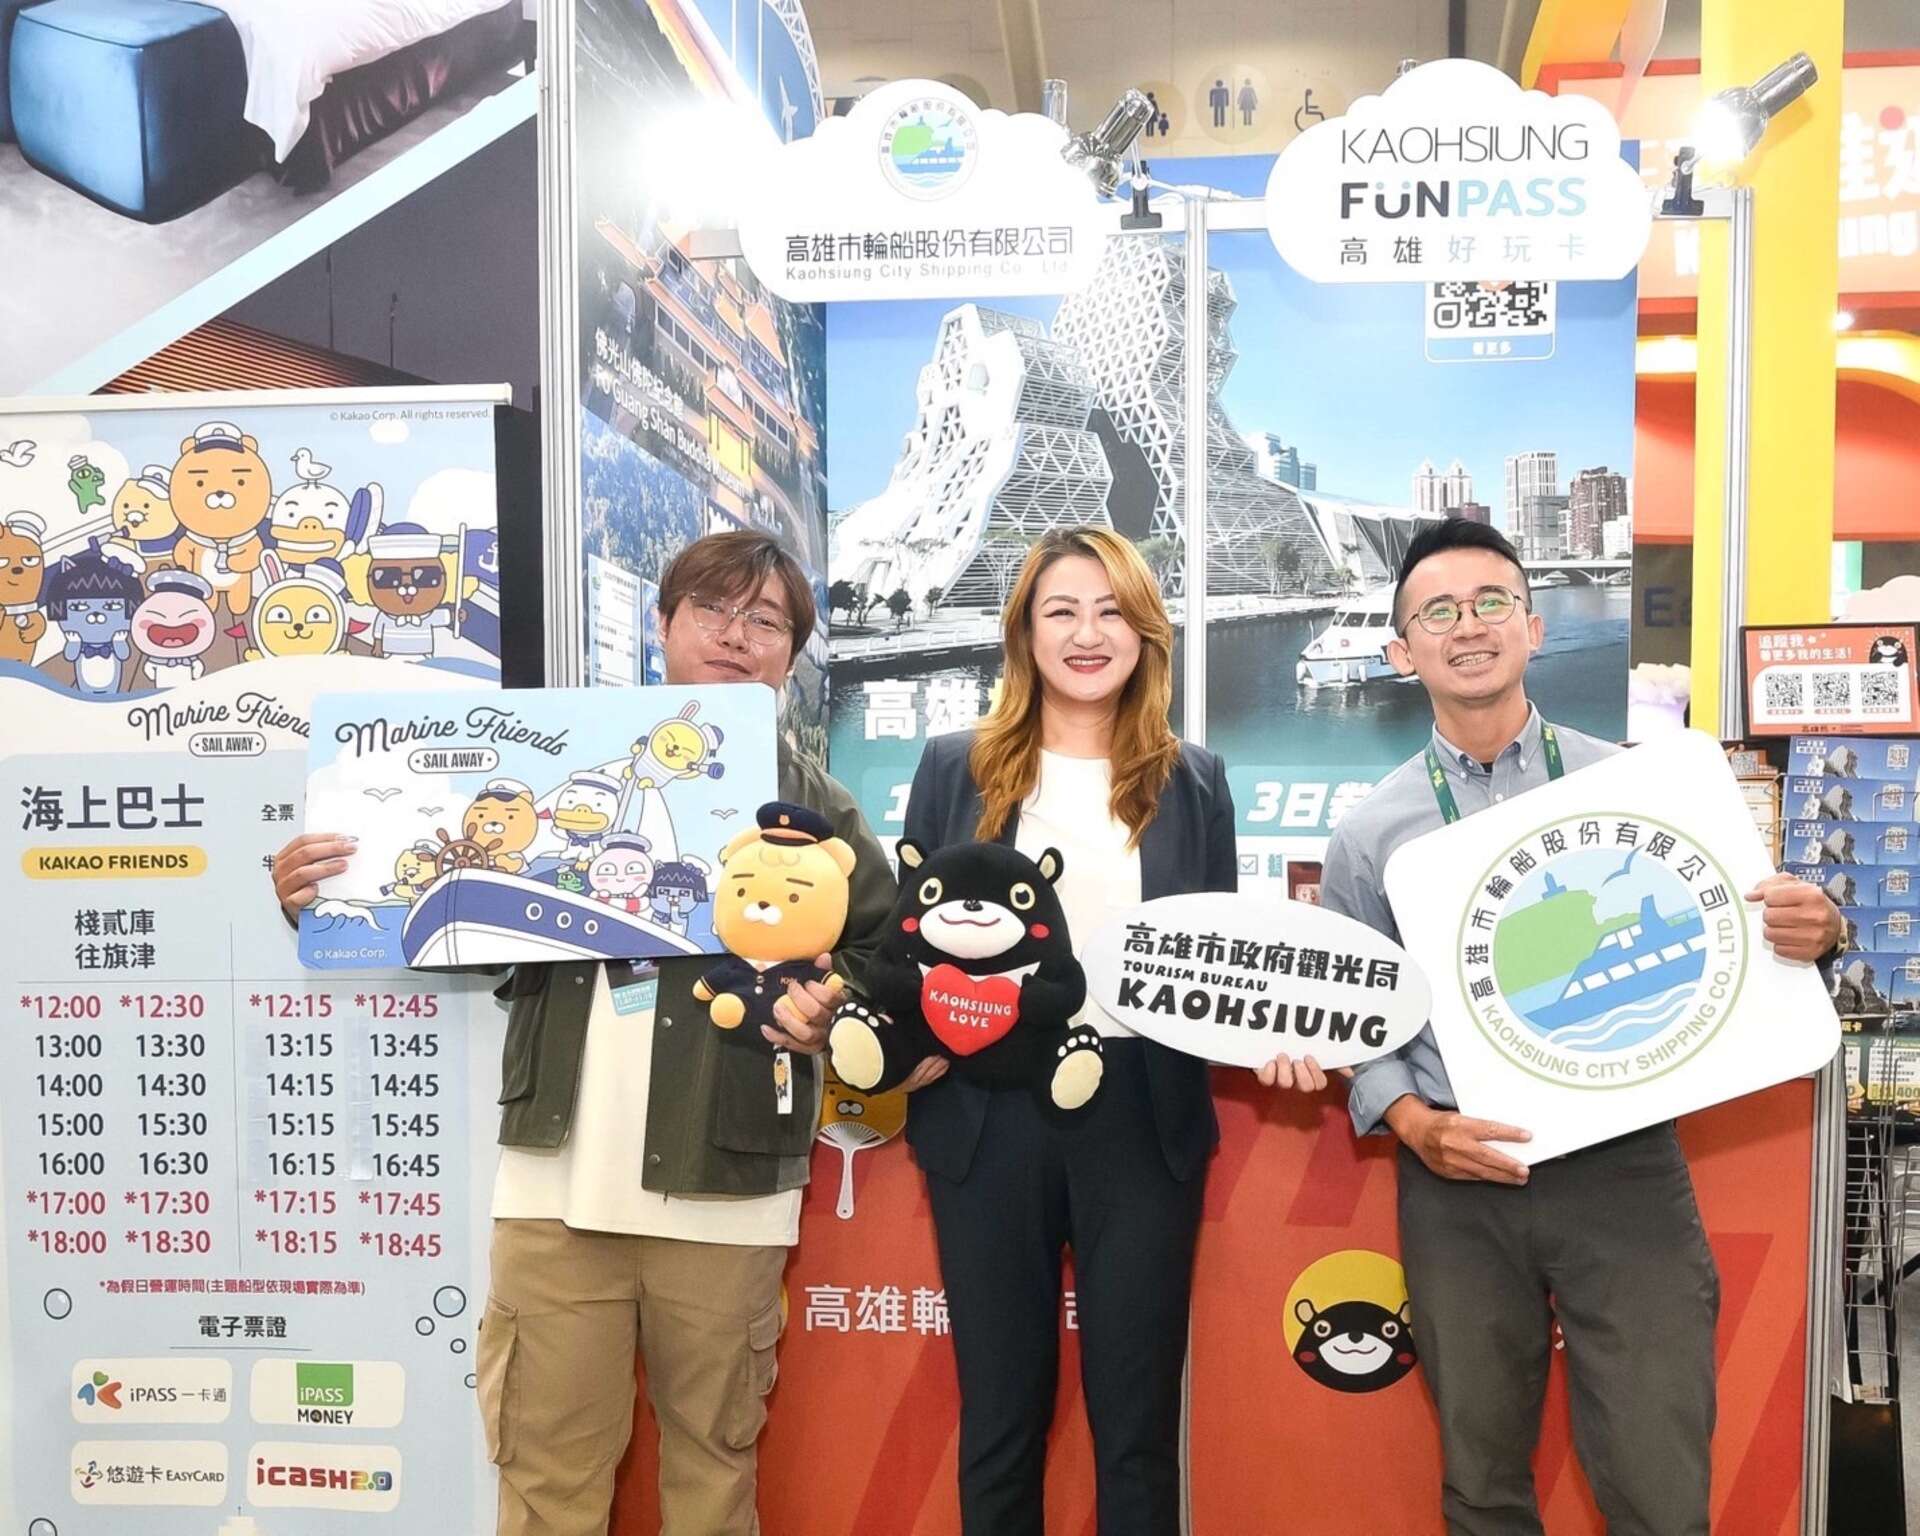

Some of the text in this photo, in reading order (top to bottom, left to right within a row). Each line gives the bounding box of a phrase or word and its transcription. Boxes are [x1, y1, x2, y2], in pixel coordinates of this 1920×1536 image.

[1341, 123, 1589, 164] KAOHSIUNG
[785, 226, 1074, 263] 高雄市輪船股份有限公司
[786, 265, 872, 282] Kaohsiung
[880, 264, 912, 280] City
[920, 262, 992, 278] Shipping
[340, 411, 370, 421] Kakao
[400, 409, 414, 419] All
[415, 408, 444, 421] rights
[612, 376, 650, 431] Guang
[650, 405, 676, 445] Shan
[676, 428, 712, 472] Buddha
[128, 703, 230, 741] Marine
[335, 706, 569, 757] Marine Friends
[202, 736, 253, 752] SAIL AWAY
[423, 752, 485, 769] SAIL AWAY
[20, 783, 204, 832] 海上巴士
[261, 804, 295, 821] 全票
[39, 854, 188, 870] KAKAO FRIENDS
[75, 909, 155, 936] 棧貳庫
[1465, 821, 1728, 1002] 高雄市輪船股份有限公司
[75, 943, 156, 969] 往旗津
[324, 948, 356, 960] Kakao
[360, 947, 388, 962] Corp.
[1124, 922, 1400, 991] 高雄市政府觀光局
[1124, 960, 1268, 992] TOURISM BUREAU
[929, 990, 1012, 1016] KAOHSIUNG
[1117, 978, 1387, 1047] KAOHSIUNG
[949, 1011, 990, 1028] LOVE
[36, 1034, 438, 1057] 13:00 13:30 13:15 13:45
[1481, 1003, 1580, 1078] KAOHSIUNG
[1586, 1060, 1630, 1079] CITY
[1636, 1002, 1717, 1071] SHIPPING
[37, 1073, 439, 1097] 14:00 14:30 14:15 14:45
[38, 1113, 439, 1137] 15:00 15:30 15:15 15:45
[39, 1152, 439, 1177] 16:00 16:30 16:15 16:45
[198, 1315, 287, 1338] 電子票證
[130, 1387, 227, 1402] iPASS 一卡通
[300, 1387, 344, 1402] iPASS
[297, 1408, 353, 1424] MONEY
[106, 1465, 163, 1484] 悠遊卡
